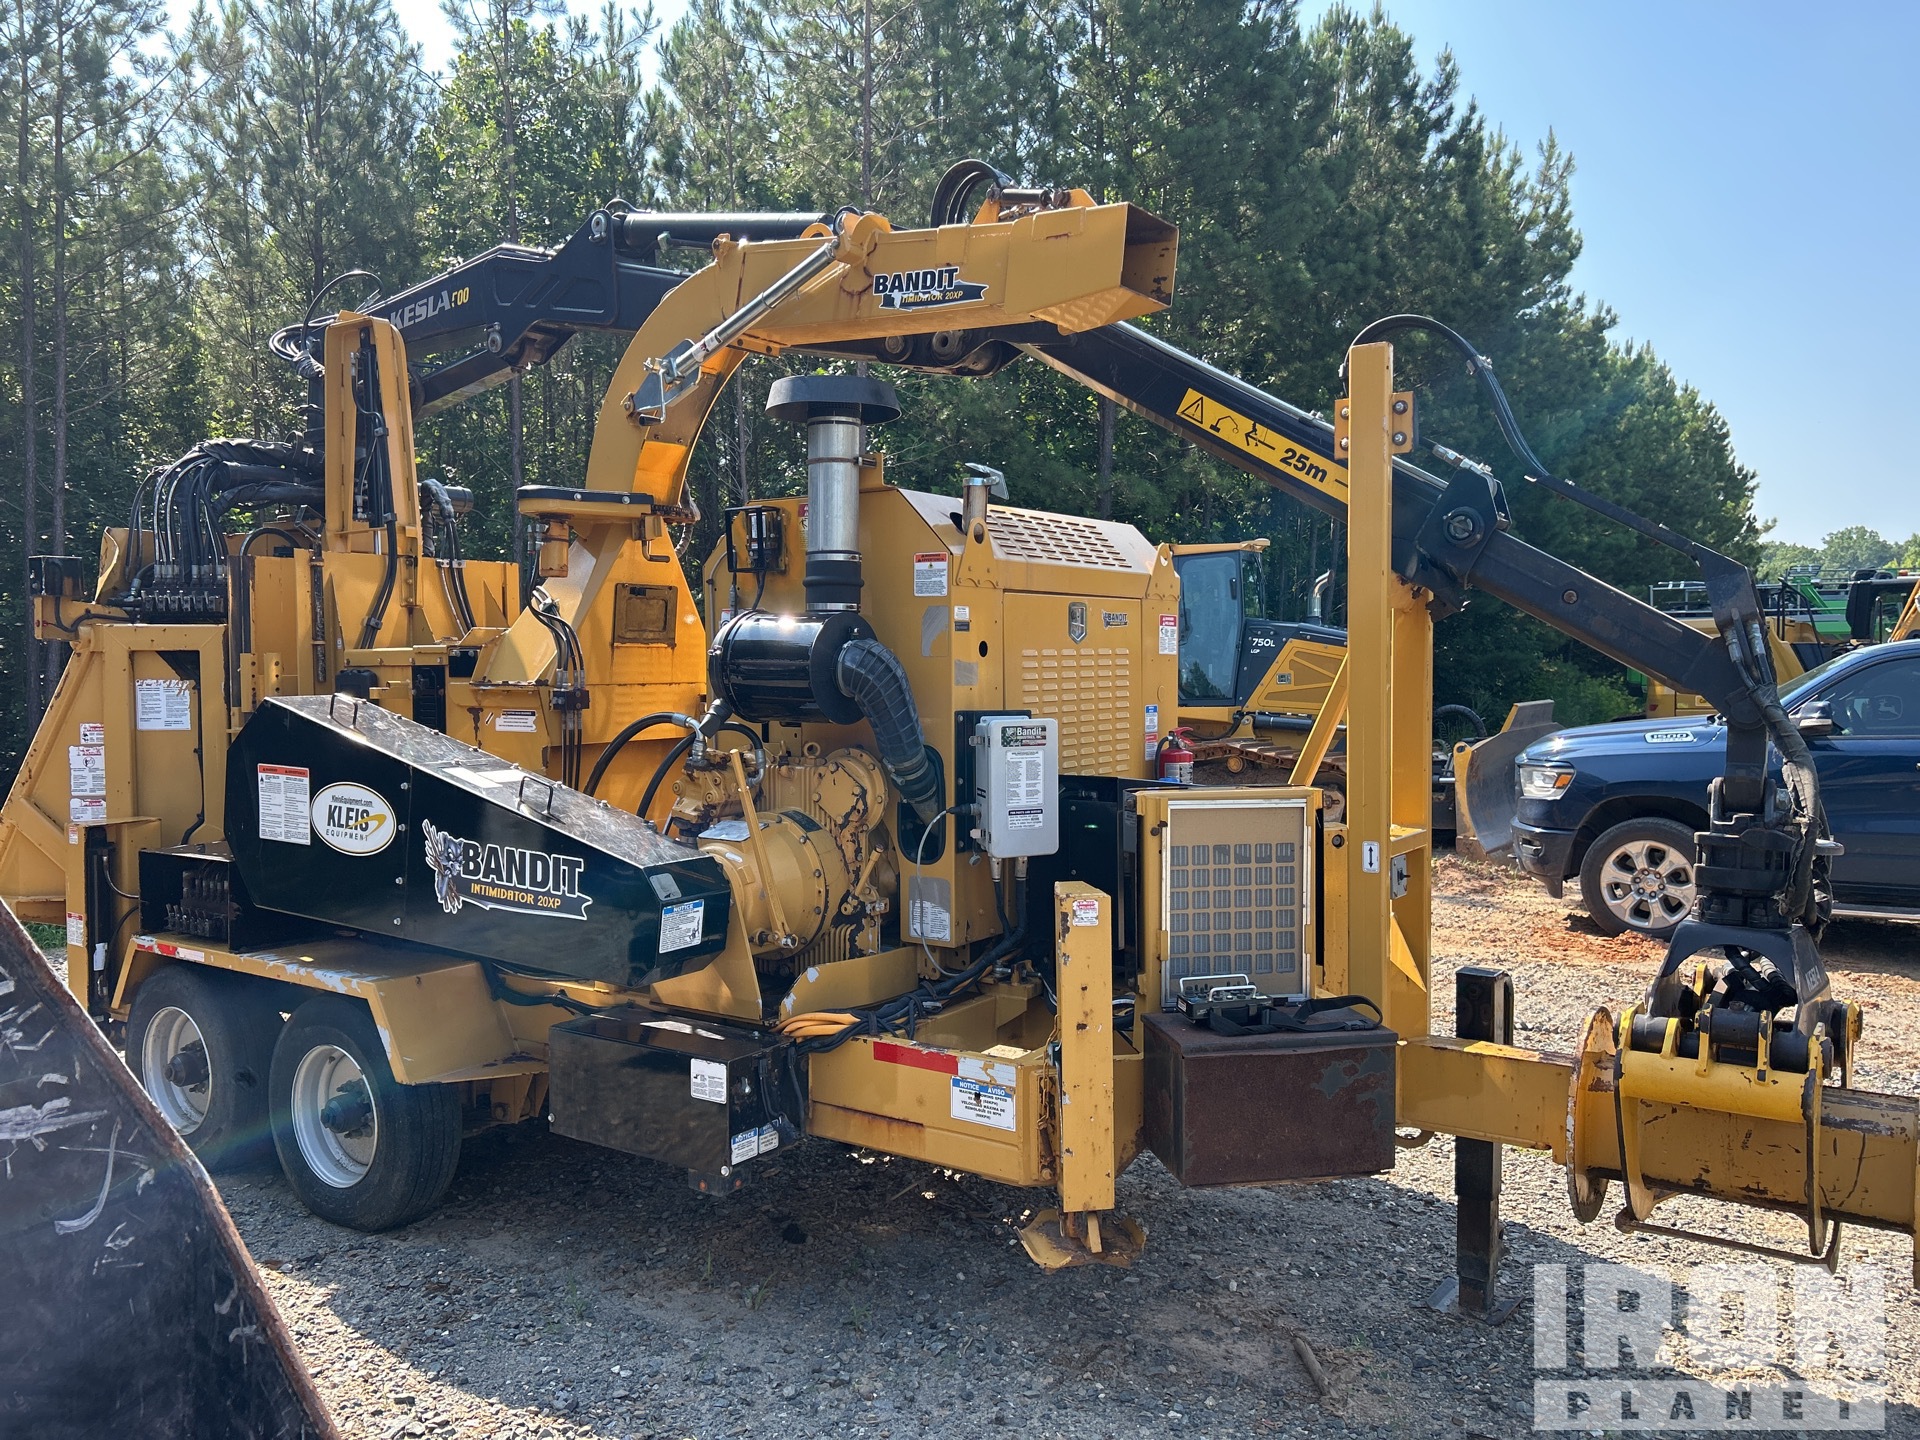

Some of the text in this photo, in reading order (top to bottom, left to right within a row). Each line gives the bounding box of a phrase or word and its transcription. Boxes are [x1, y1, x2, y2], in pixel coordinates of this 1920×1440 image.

[874, 267, 959, 295] BANDIT
[945, 290, 964, 300] 20XP
[390, 290, 451, 330] KESLA
[1279, 447, 1328, 483] 25m
[1108, 613, 1128, 621] BANDIT
[1252, 638, 1276, 647] 750L
[1017, 726, 1042, 736] Bandit
[327, 804, 370, 832] KLEIS
[325, 829, 368, 841] EQUIPMENT
[462, 841, 584, 897] BANDIT
[471, 883, 561, 909] INTIMIDATOR 20XP
[960, 1081, 1005, 1096] NOTICE AVISO
[735, 1131, 755, 1143] NOTICE
